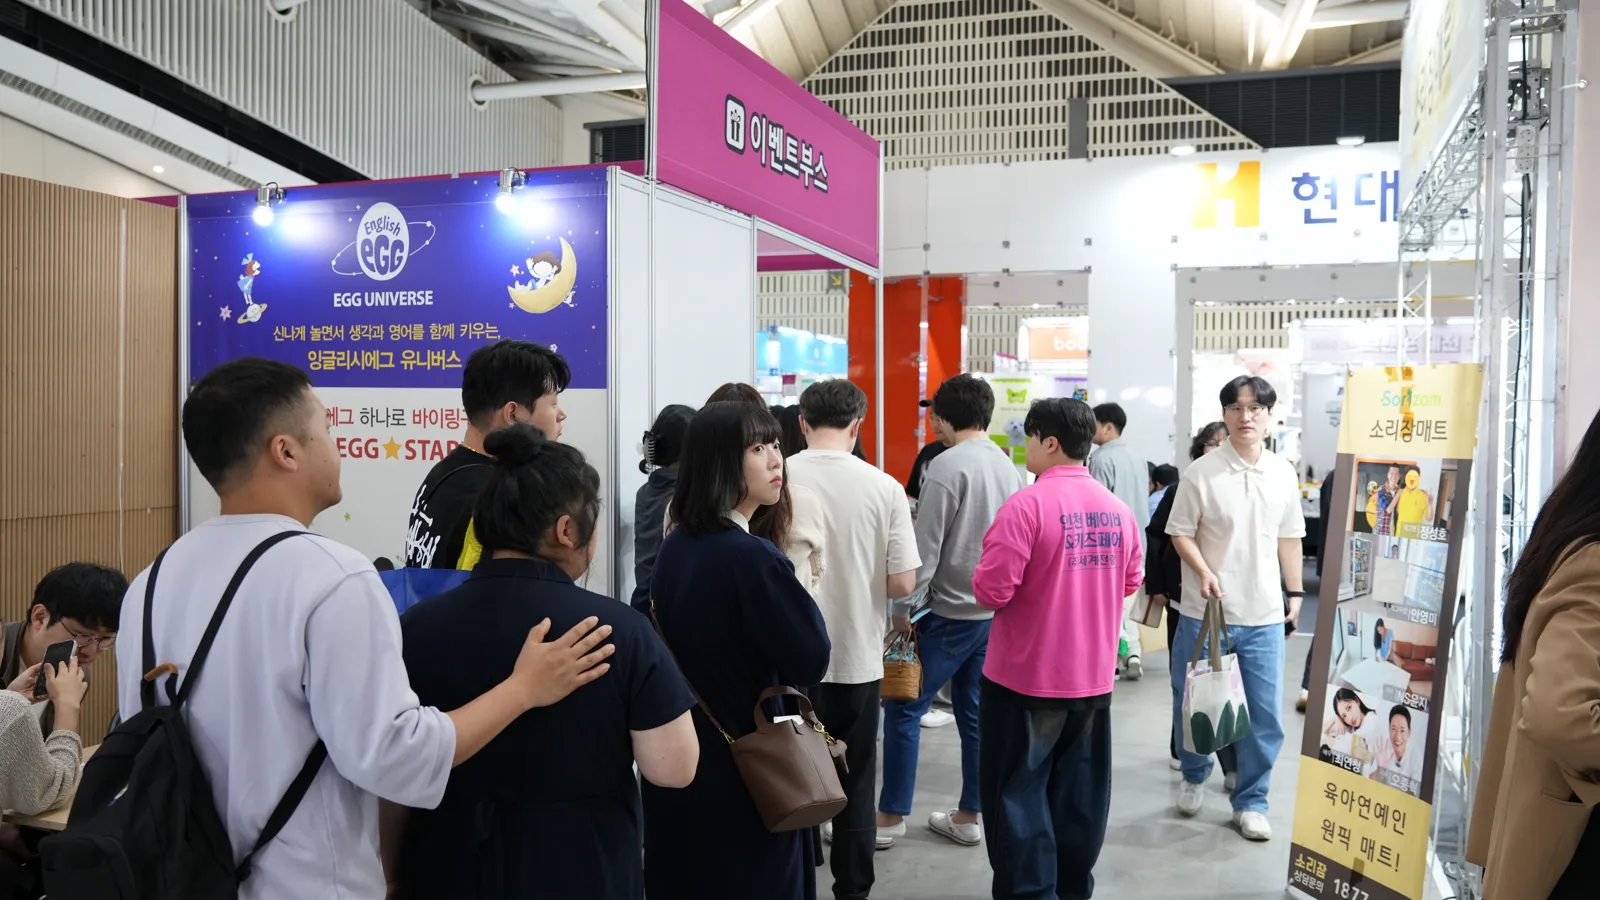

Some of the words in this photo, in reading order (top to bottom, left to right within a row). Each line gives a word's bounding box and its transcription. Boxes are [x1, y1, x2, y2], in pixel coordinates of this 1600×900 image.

[751, 112, 828, 193] 이벤트부스
[1291, 170, 1399, 224] 현대
[364, 215, 401, 237] English
[333, 292, 362, 307] EGG
[364, 290, 434, 306] UNIVERSE
[273, 325, 306, 342] 신나게
[310, 324, 344, 341] 놀면서
[348, 324, 384, 341] 생각과
[388, 323, 425, 341] 영어를
[429, 323, 455, 340] 함께
[460, 322, 501, 341] 키우는,
[307, 349, 395, 371] 잉글리시에그
[400, 349, 463, 370] 유니버스
[359, 407, 407, 428] 하나로
[1369, 418, 1448, 443] 소리잠매트
[336, 437, 379, 459] EGG
[1059, 512, 1083, 530] 인천
[1065, 531, 1123, 550] &키즈페어
[1419, 525, 1448, 541] 정성호
[1410, 608, 1438, 626] 안영미
[1324, 782, 1407, 835] 육아연예인
[1320, 819, 1352, 851] 원픽
[1360, 836, 1400, 873] 매트!
[1294, 853, 1328, 880] 소리잠
[1293, 869, 1325, 894] 상담문의
[1333, 878, 1370, 900] 1877
